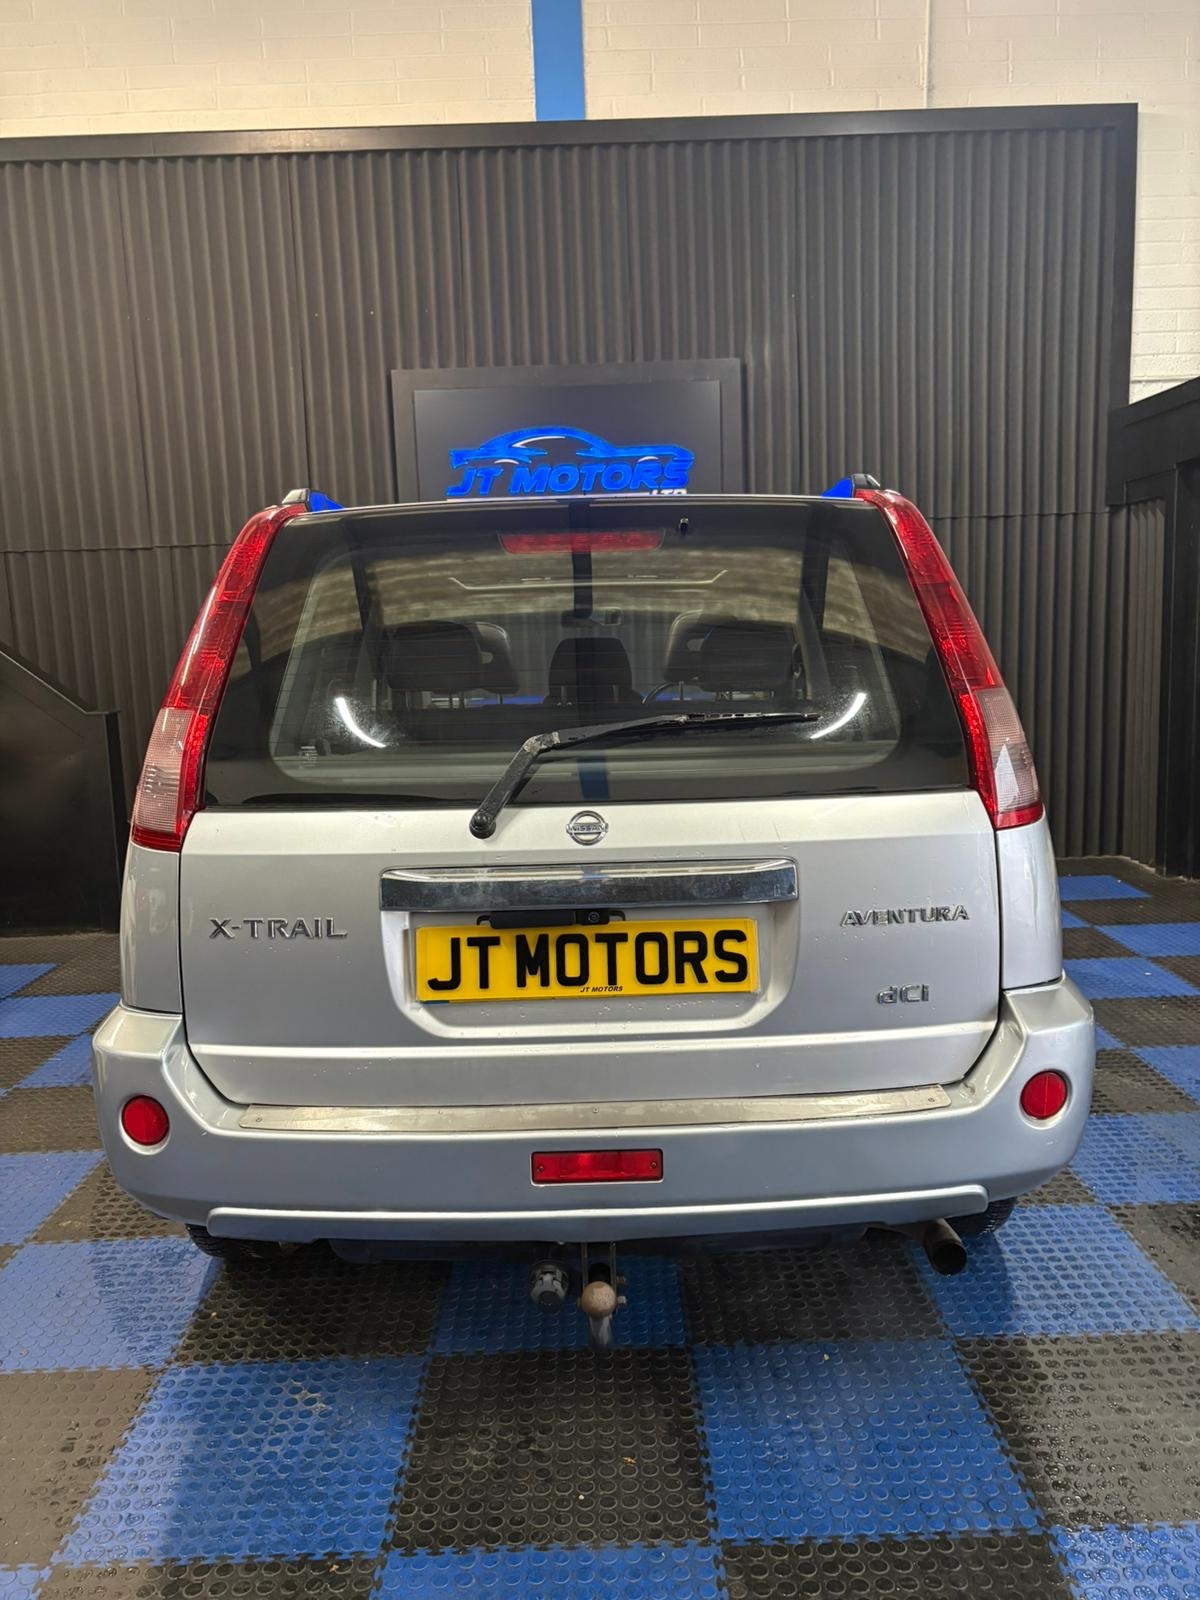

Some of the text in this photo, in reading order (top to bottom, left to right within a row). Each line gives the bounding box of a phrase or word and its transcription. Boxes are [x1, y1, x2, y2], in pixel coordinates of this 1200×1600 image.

[447, 462, 693, 496] JT MOTORS
[840, 904, 970, 927] AVENTURA
[209, 917, 348, 939] X-TRAIL
[427, 929, 748, 991] JT MOTORS
[591, 985, 623, 993] MOTORS
